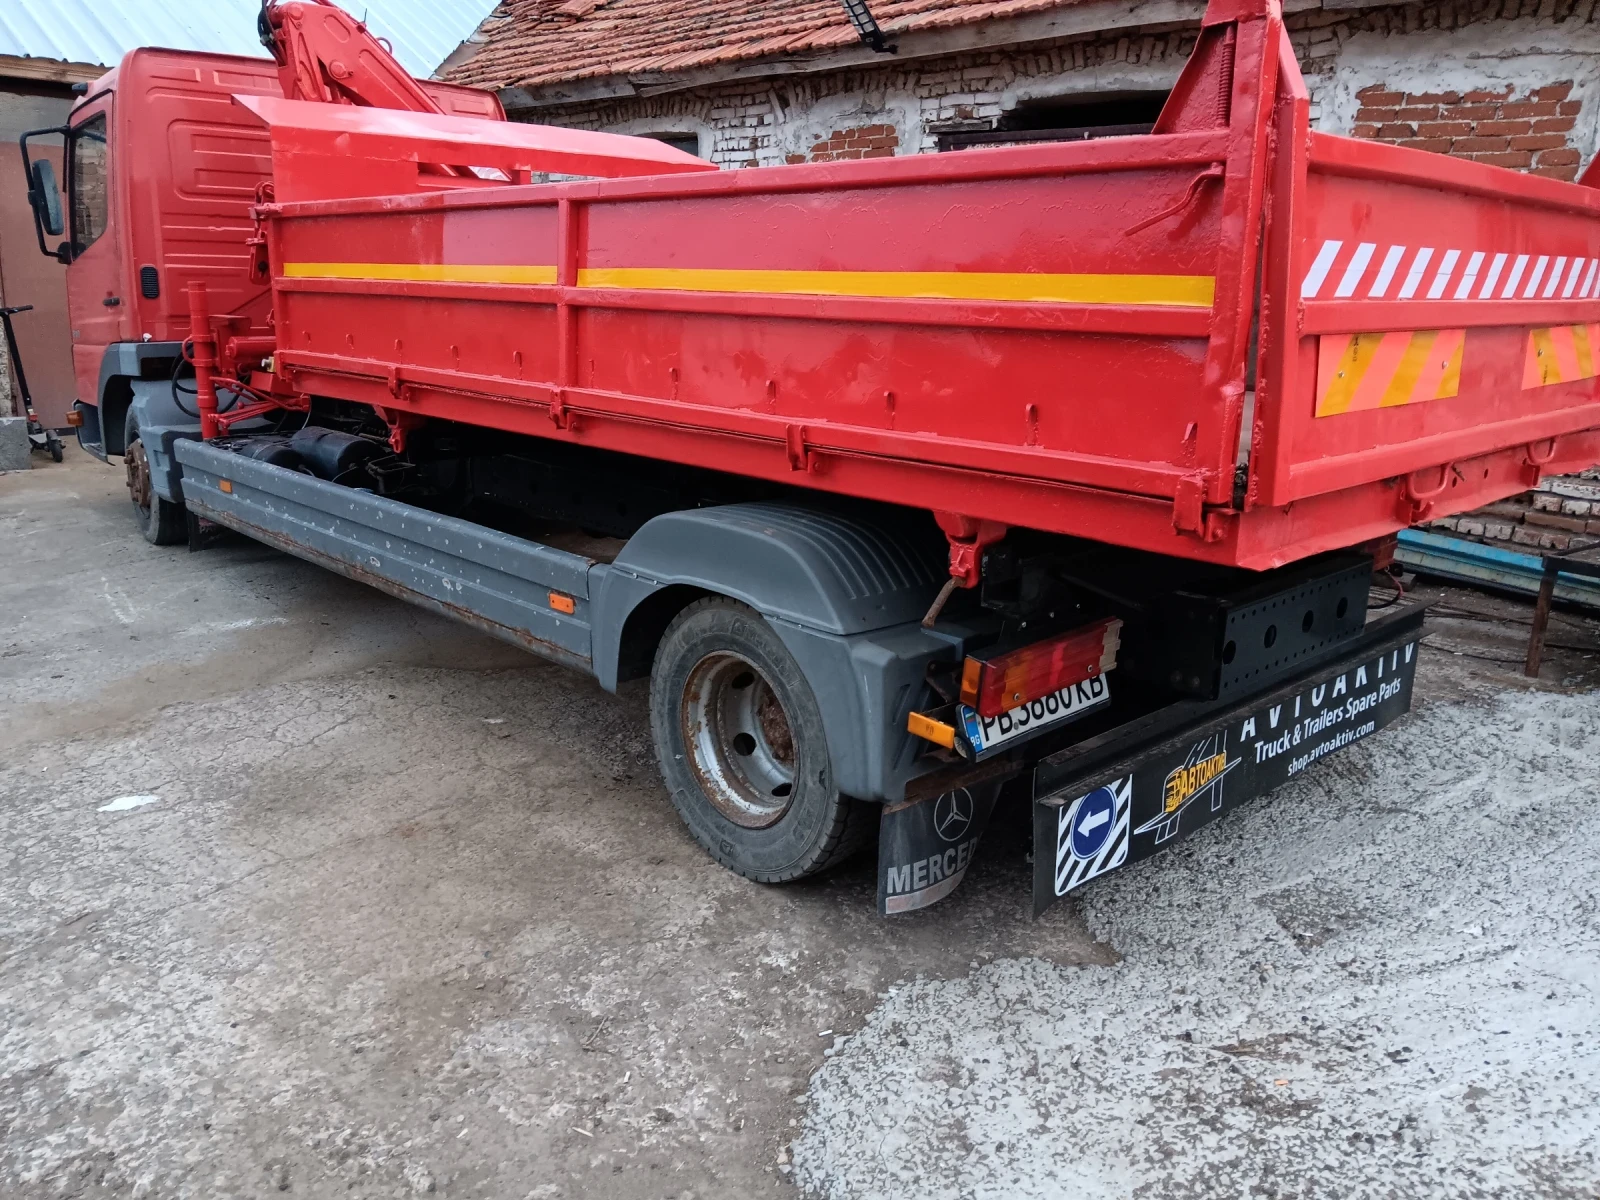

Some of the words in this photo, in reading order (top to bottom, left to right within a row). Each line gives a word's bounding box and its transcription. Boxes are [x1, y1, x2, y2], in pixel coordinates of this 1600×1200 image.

[1255, 730, 1291, 764] Truck
[1292, 724, 1301, 745] &
[1303, 706, 1344, 739] Trailers
[1345, 691, 1376, 721] Spare
[1379, 677, 1401, 703] Parts
[1287, 720, 1375, 778] shop.avtoaktiv.com
